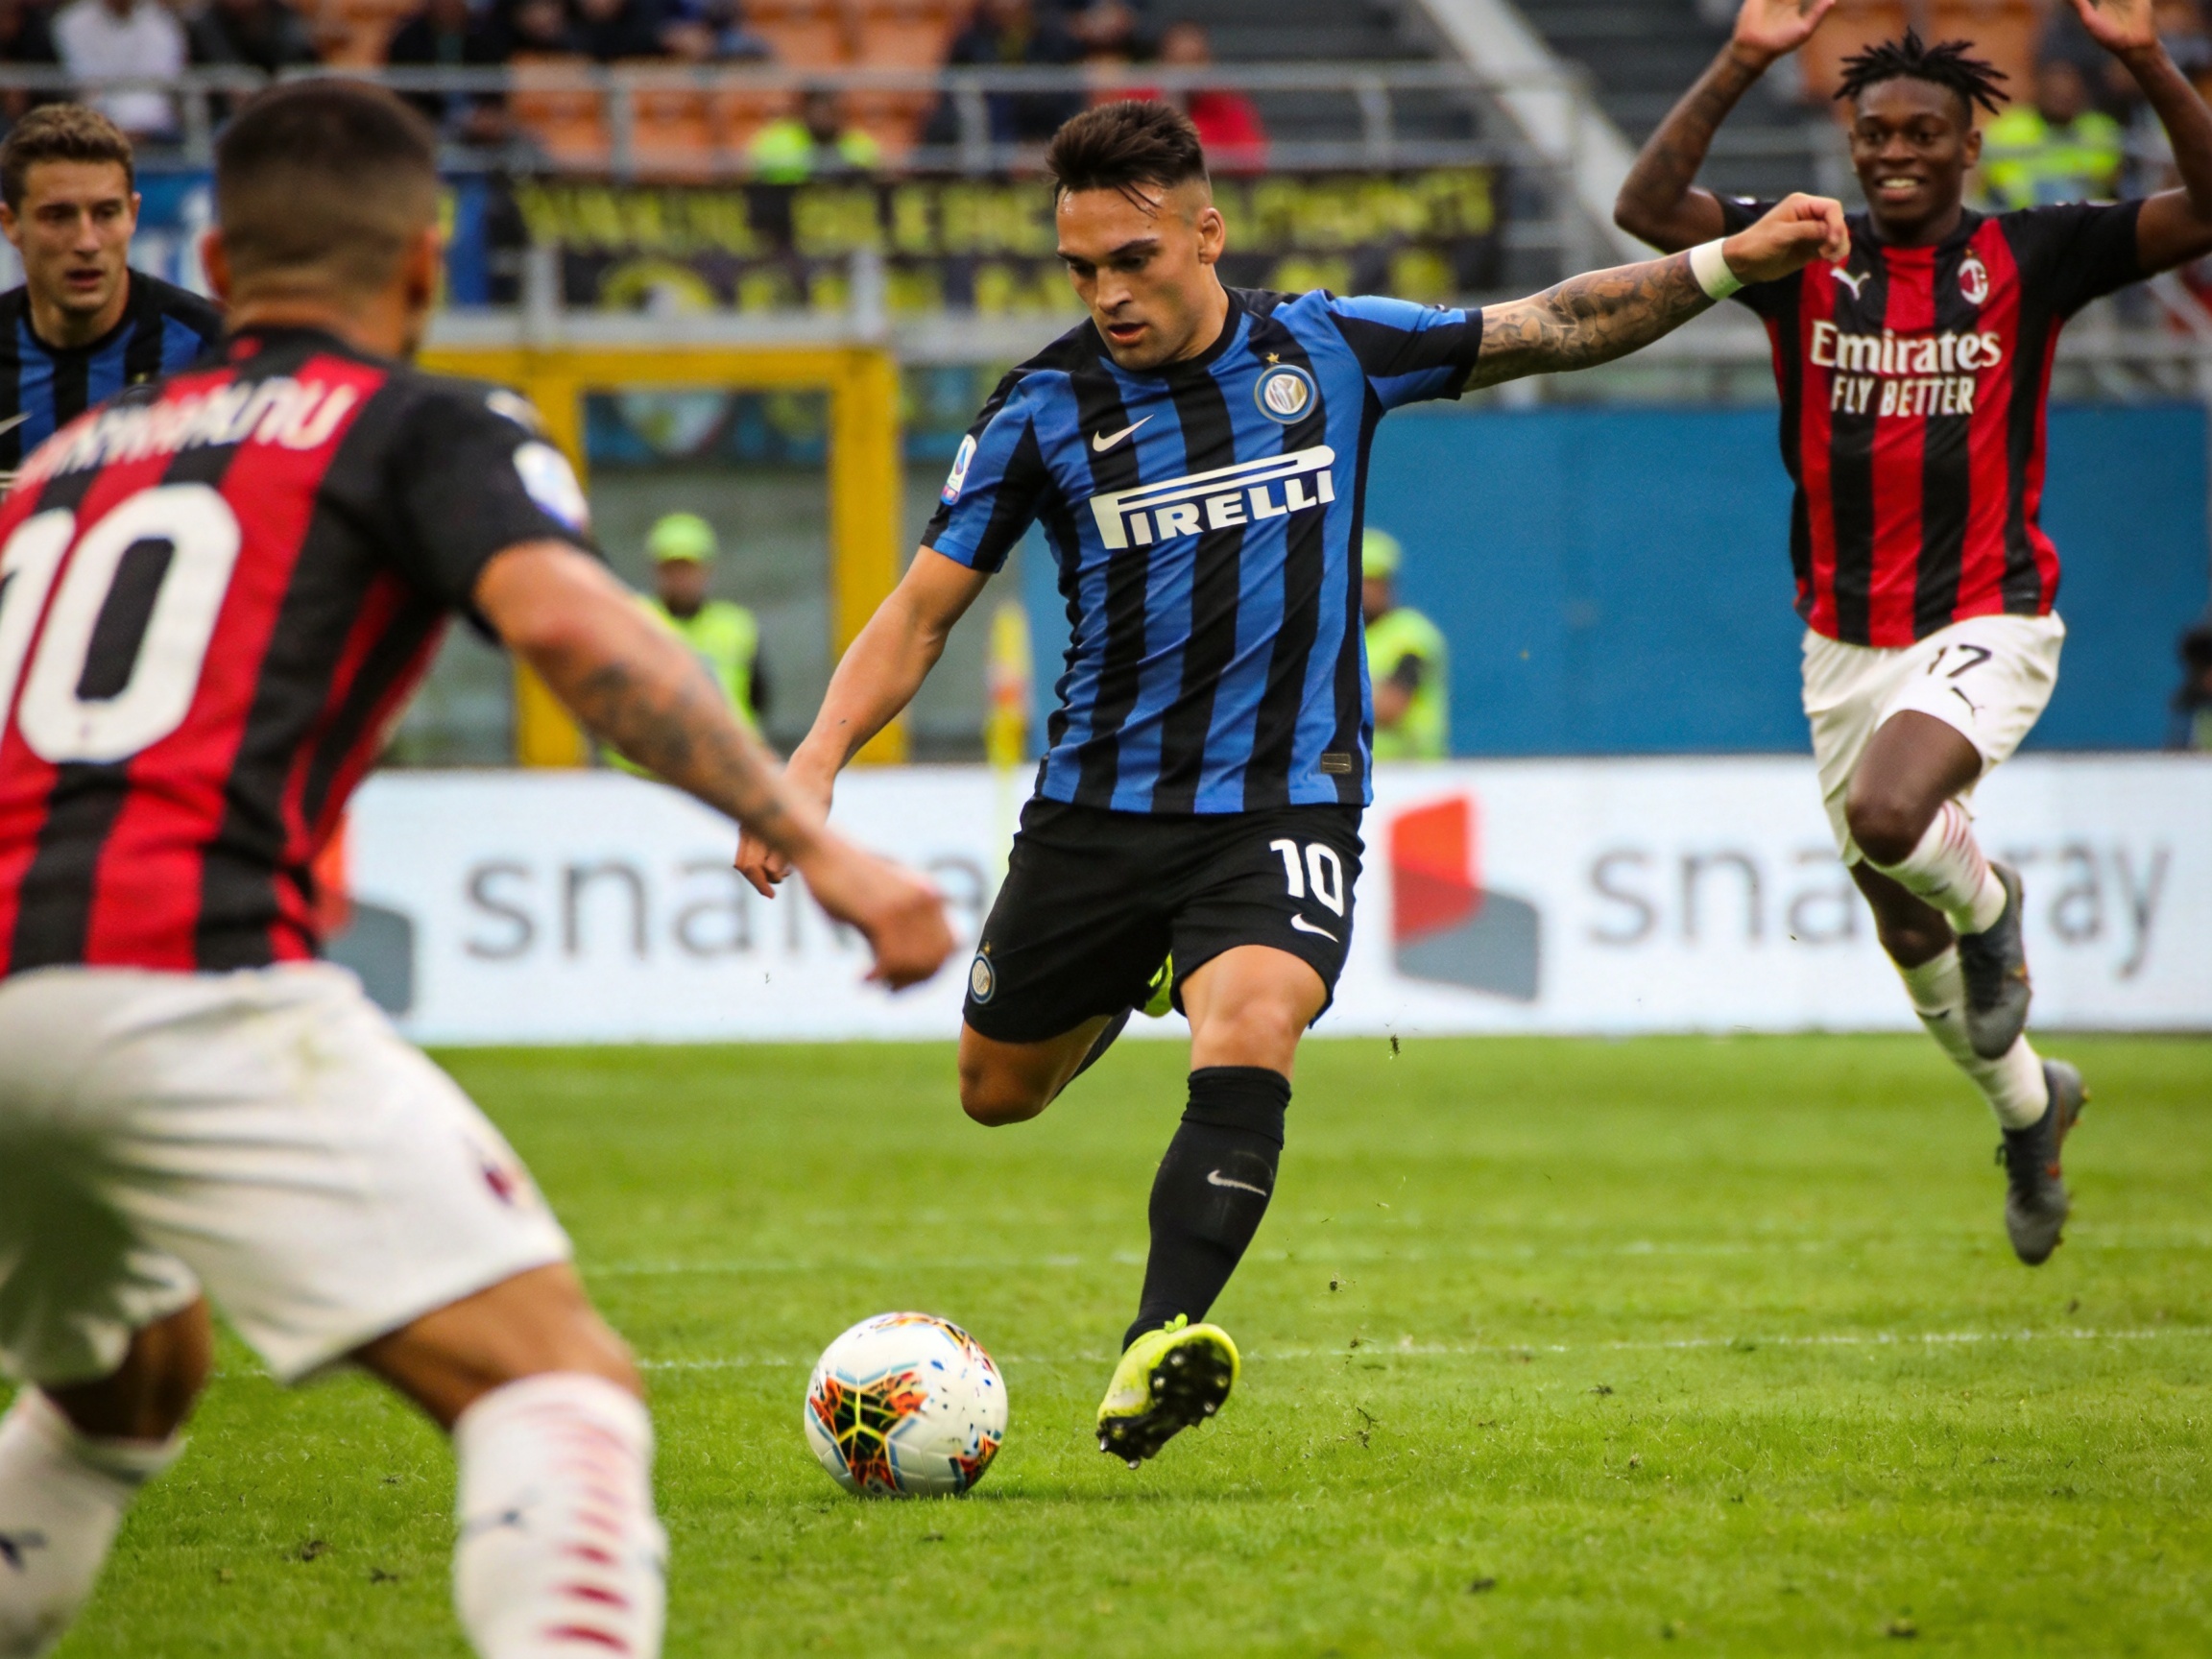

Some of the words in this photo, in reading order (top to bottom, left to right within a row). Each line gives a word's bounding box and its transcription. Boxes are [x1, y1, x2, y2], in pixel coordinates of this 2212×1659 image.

[1810, 319, 2003, 373] Emirates
[1831, 375, 1875, 415] FLY
[1879, 375, 1976, 418] BETTER
[1090, 445, 1336, 550] PIRELLI
[0, 483, 242, 764] 10
[1926, 643, 1993, 679] 17
[1269, 837, 1344, 918] 10
